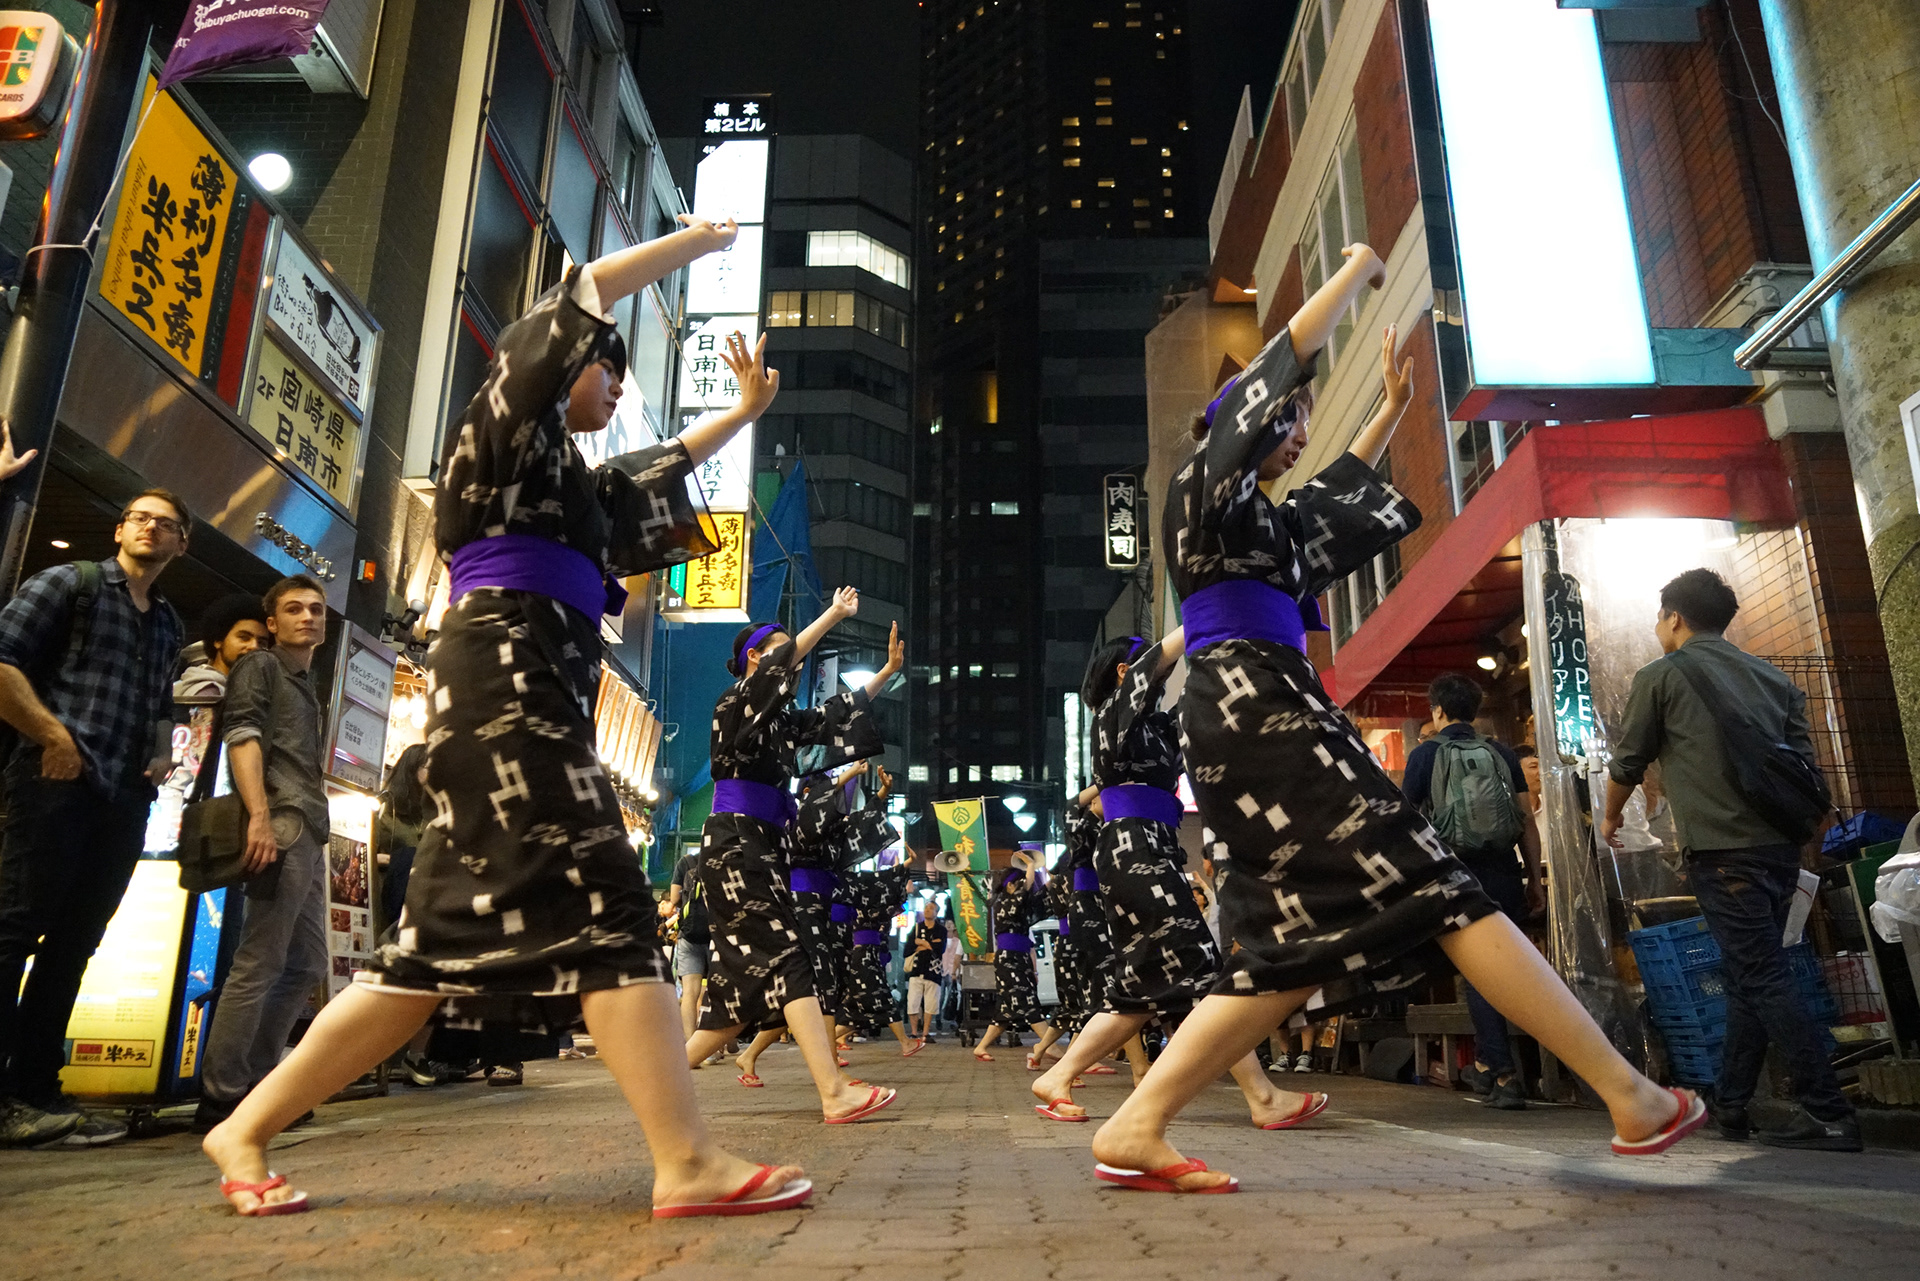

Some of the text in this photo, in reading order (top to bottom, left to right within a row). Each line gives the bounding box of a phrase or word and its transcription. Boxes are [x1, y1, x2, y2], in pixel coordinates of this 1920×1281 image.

[704, 117, 766, 133] 第2ビル
[257, 375, 275, 400] 2F
[693, 334, 718, 398] 日南市
[279, 367, 344, 451] 宮崎県
[275, 411, 342, 491] 日南市
[1107, 481, 1136, 560] 肉寿司
